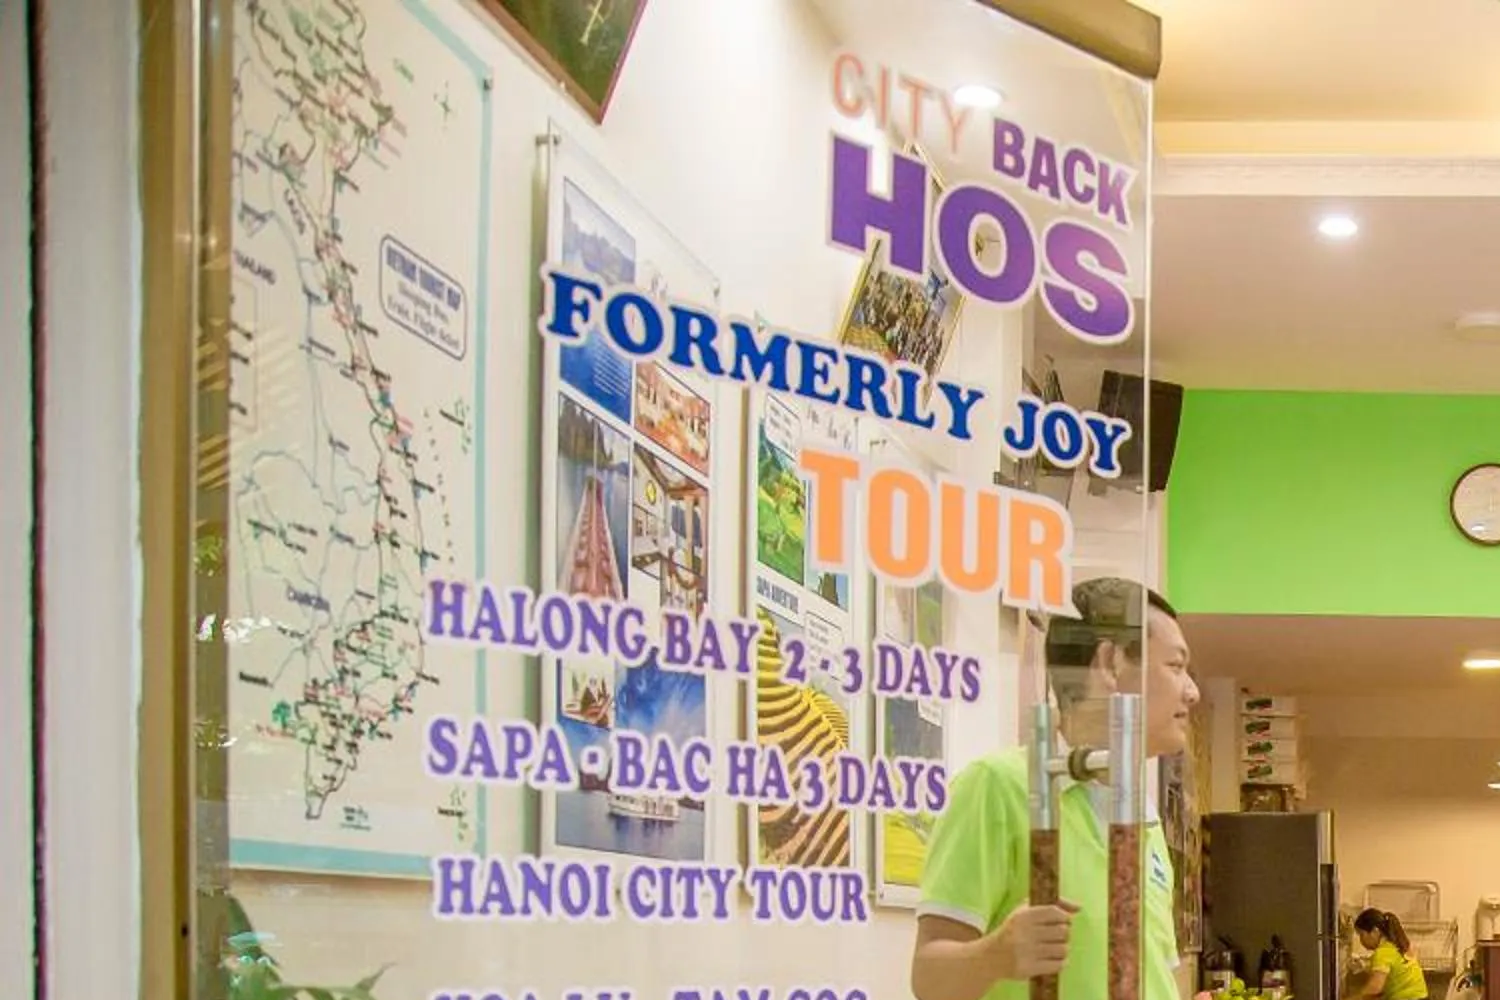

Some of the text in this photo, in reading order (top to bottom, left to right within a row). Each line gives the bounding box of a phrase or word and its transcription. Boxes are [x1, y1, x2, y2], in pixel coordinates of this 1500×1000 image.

[833, 52, 1130, 225] CITY BACK
[831, 135, 1130, 338] HOS
[548, 271, 985, 440] FORMERLY
[1004, 400, 1129, 471] JOY
[801, 449, 1066, 606] TOUR
[428, 580, 645, 660] HALONG
[666, 614, 759, 674] BAY
[785, 640, 806, 682] 2
[842, 648, 863, 693] 3
[877, 643, 981, 701] DAYS
[428, 718, 572, 784] SAPA
[616, 737, 713, 793] BAC
[727, 746, 789, 800] HA
[804, 764, 821, 811] 3
[838, 756, 946, 811] DAYS
[437, 858, 868, 922] HANOI CITY TOUR
